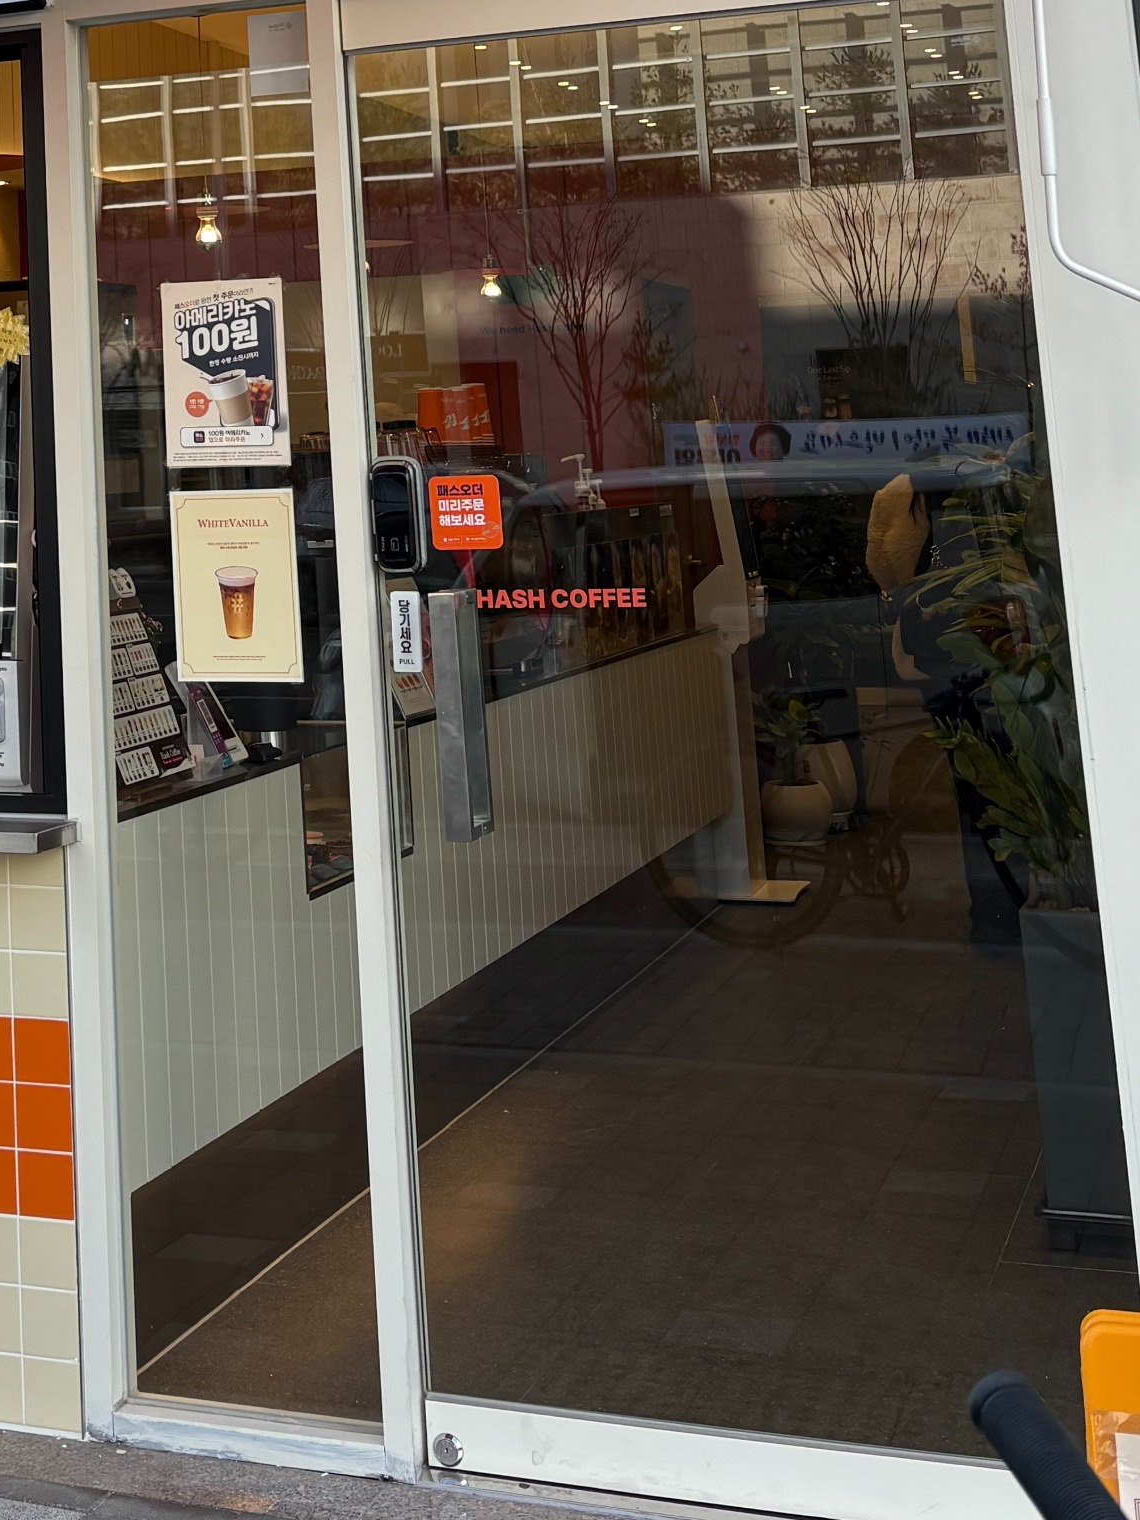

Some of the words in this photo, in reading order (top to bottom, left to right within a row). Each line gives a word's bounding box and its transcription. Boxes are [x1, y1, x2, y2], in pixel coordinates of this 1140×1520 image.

[174, 298, 257, 330] 아메리카노
[175, 316, 259, 359] 100원
[437, 483, 484, 496] 패스오더
[438, 498, 485, 512] 미리주문
[438, 513, 486, 527] 해보세요
[476, 589, 546, 610] HASH
[551, 587, 648, 609] COFFEE
[398, 599, 413, 654] 당기세요
[398, 658, 415, 666] PULL
